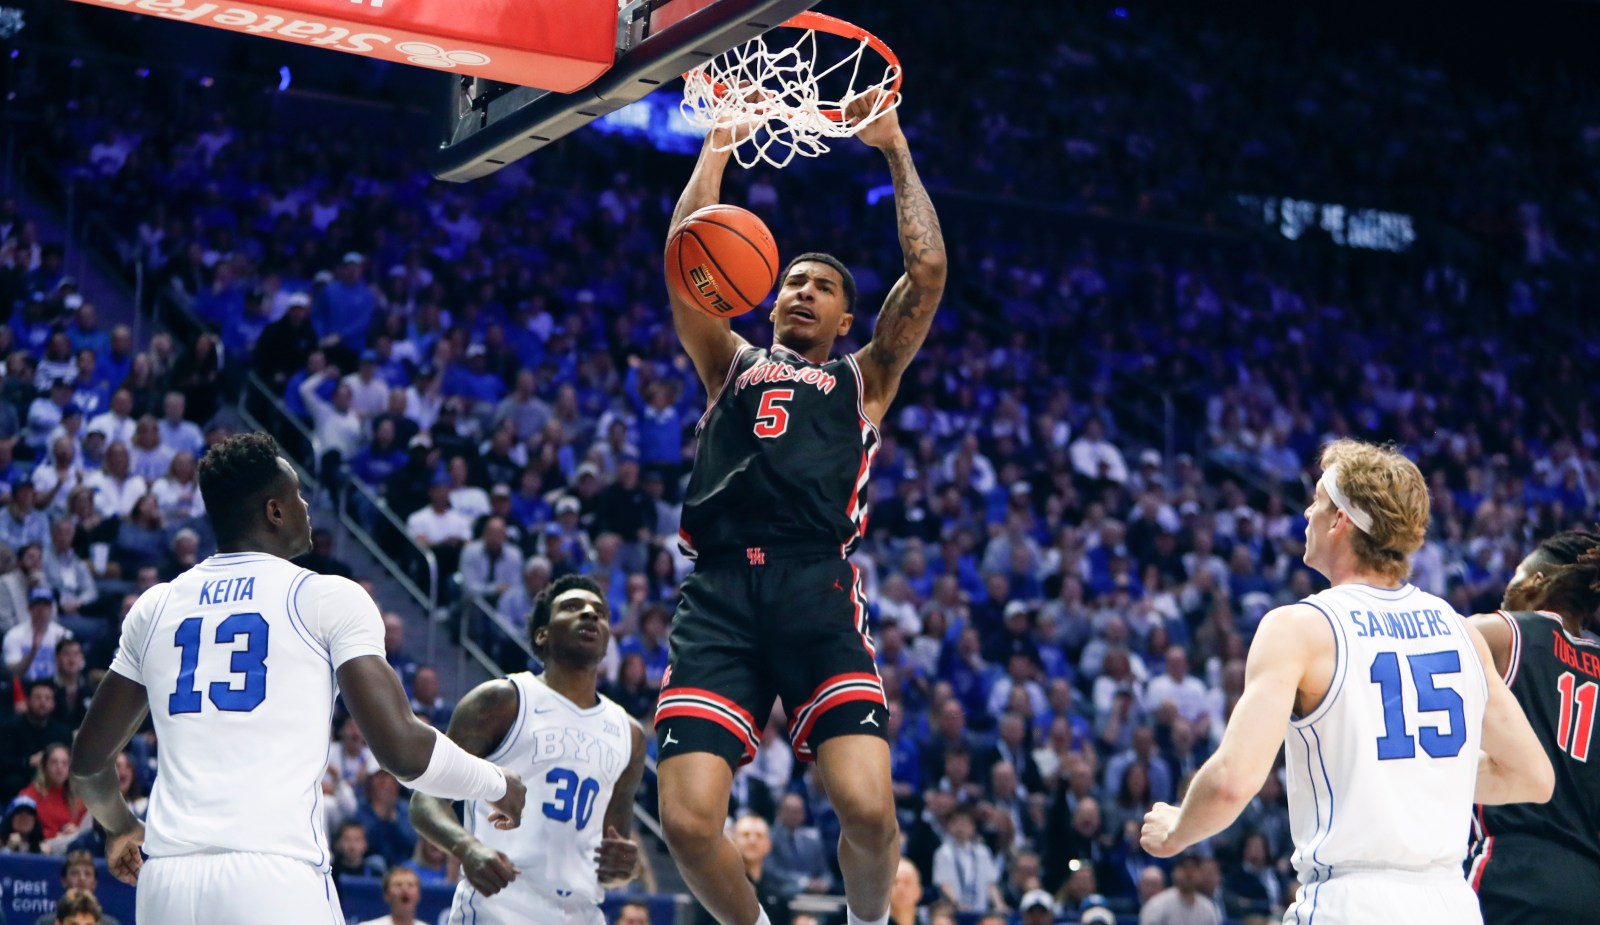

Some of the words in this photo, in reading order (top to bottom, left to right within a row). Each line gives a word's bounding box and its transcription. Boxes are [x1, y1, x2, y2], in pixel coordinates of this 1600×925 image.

[688, 265, 735, 313] ELITE
[753, 388, 795, 439] 5
[198, 576, 256, 605] KEITA
[1349, 608, 1452, 640] SAUNDERS
[168, 612, 270, 716] 13
[1551, 629, 1600, 680] TUGLER
[1369, 650, 1467, 761] 15
[1556, 671, 1600, 763] 11
[532, 727, 621, 784] BYU
[542, 767, 600, 831] 30
[12, 897, 57, 913] contr
[13, 878, 48, 897] pest
